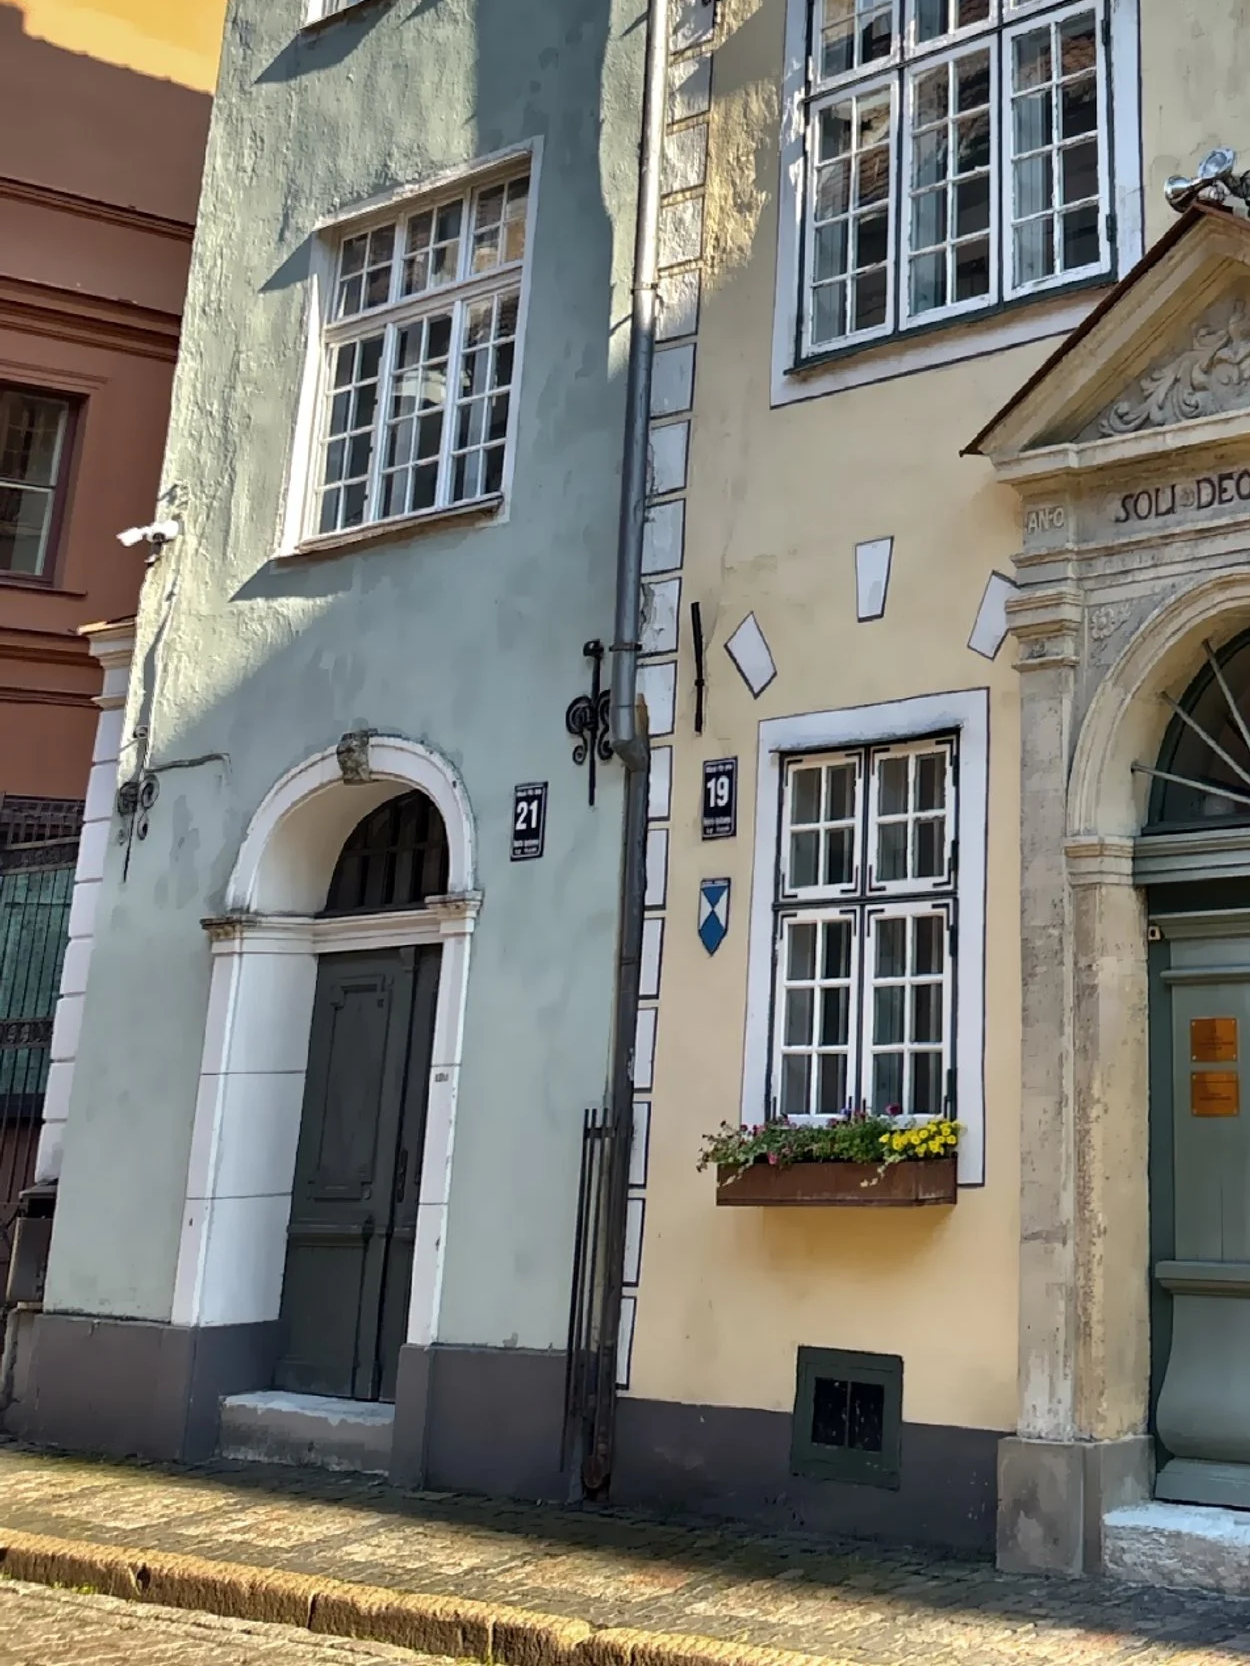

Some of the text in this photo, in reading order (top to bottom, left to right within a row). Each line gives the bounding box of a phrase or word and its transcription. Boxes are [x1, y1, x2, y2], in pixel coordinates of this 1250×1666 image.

[1115, 484, 1176, 523] SOLI
[706, 775, 730, 808] 19
[515, 799, 538, 831] 21
